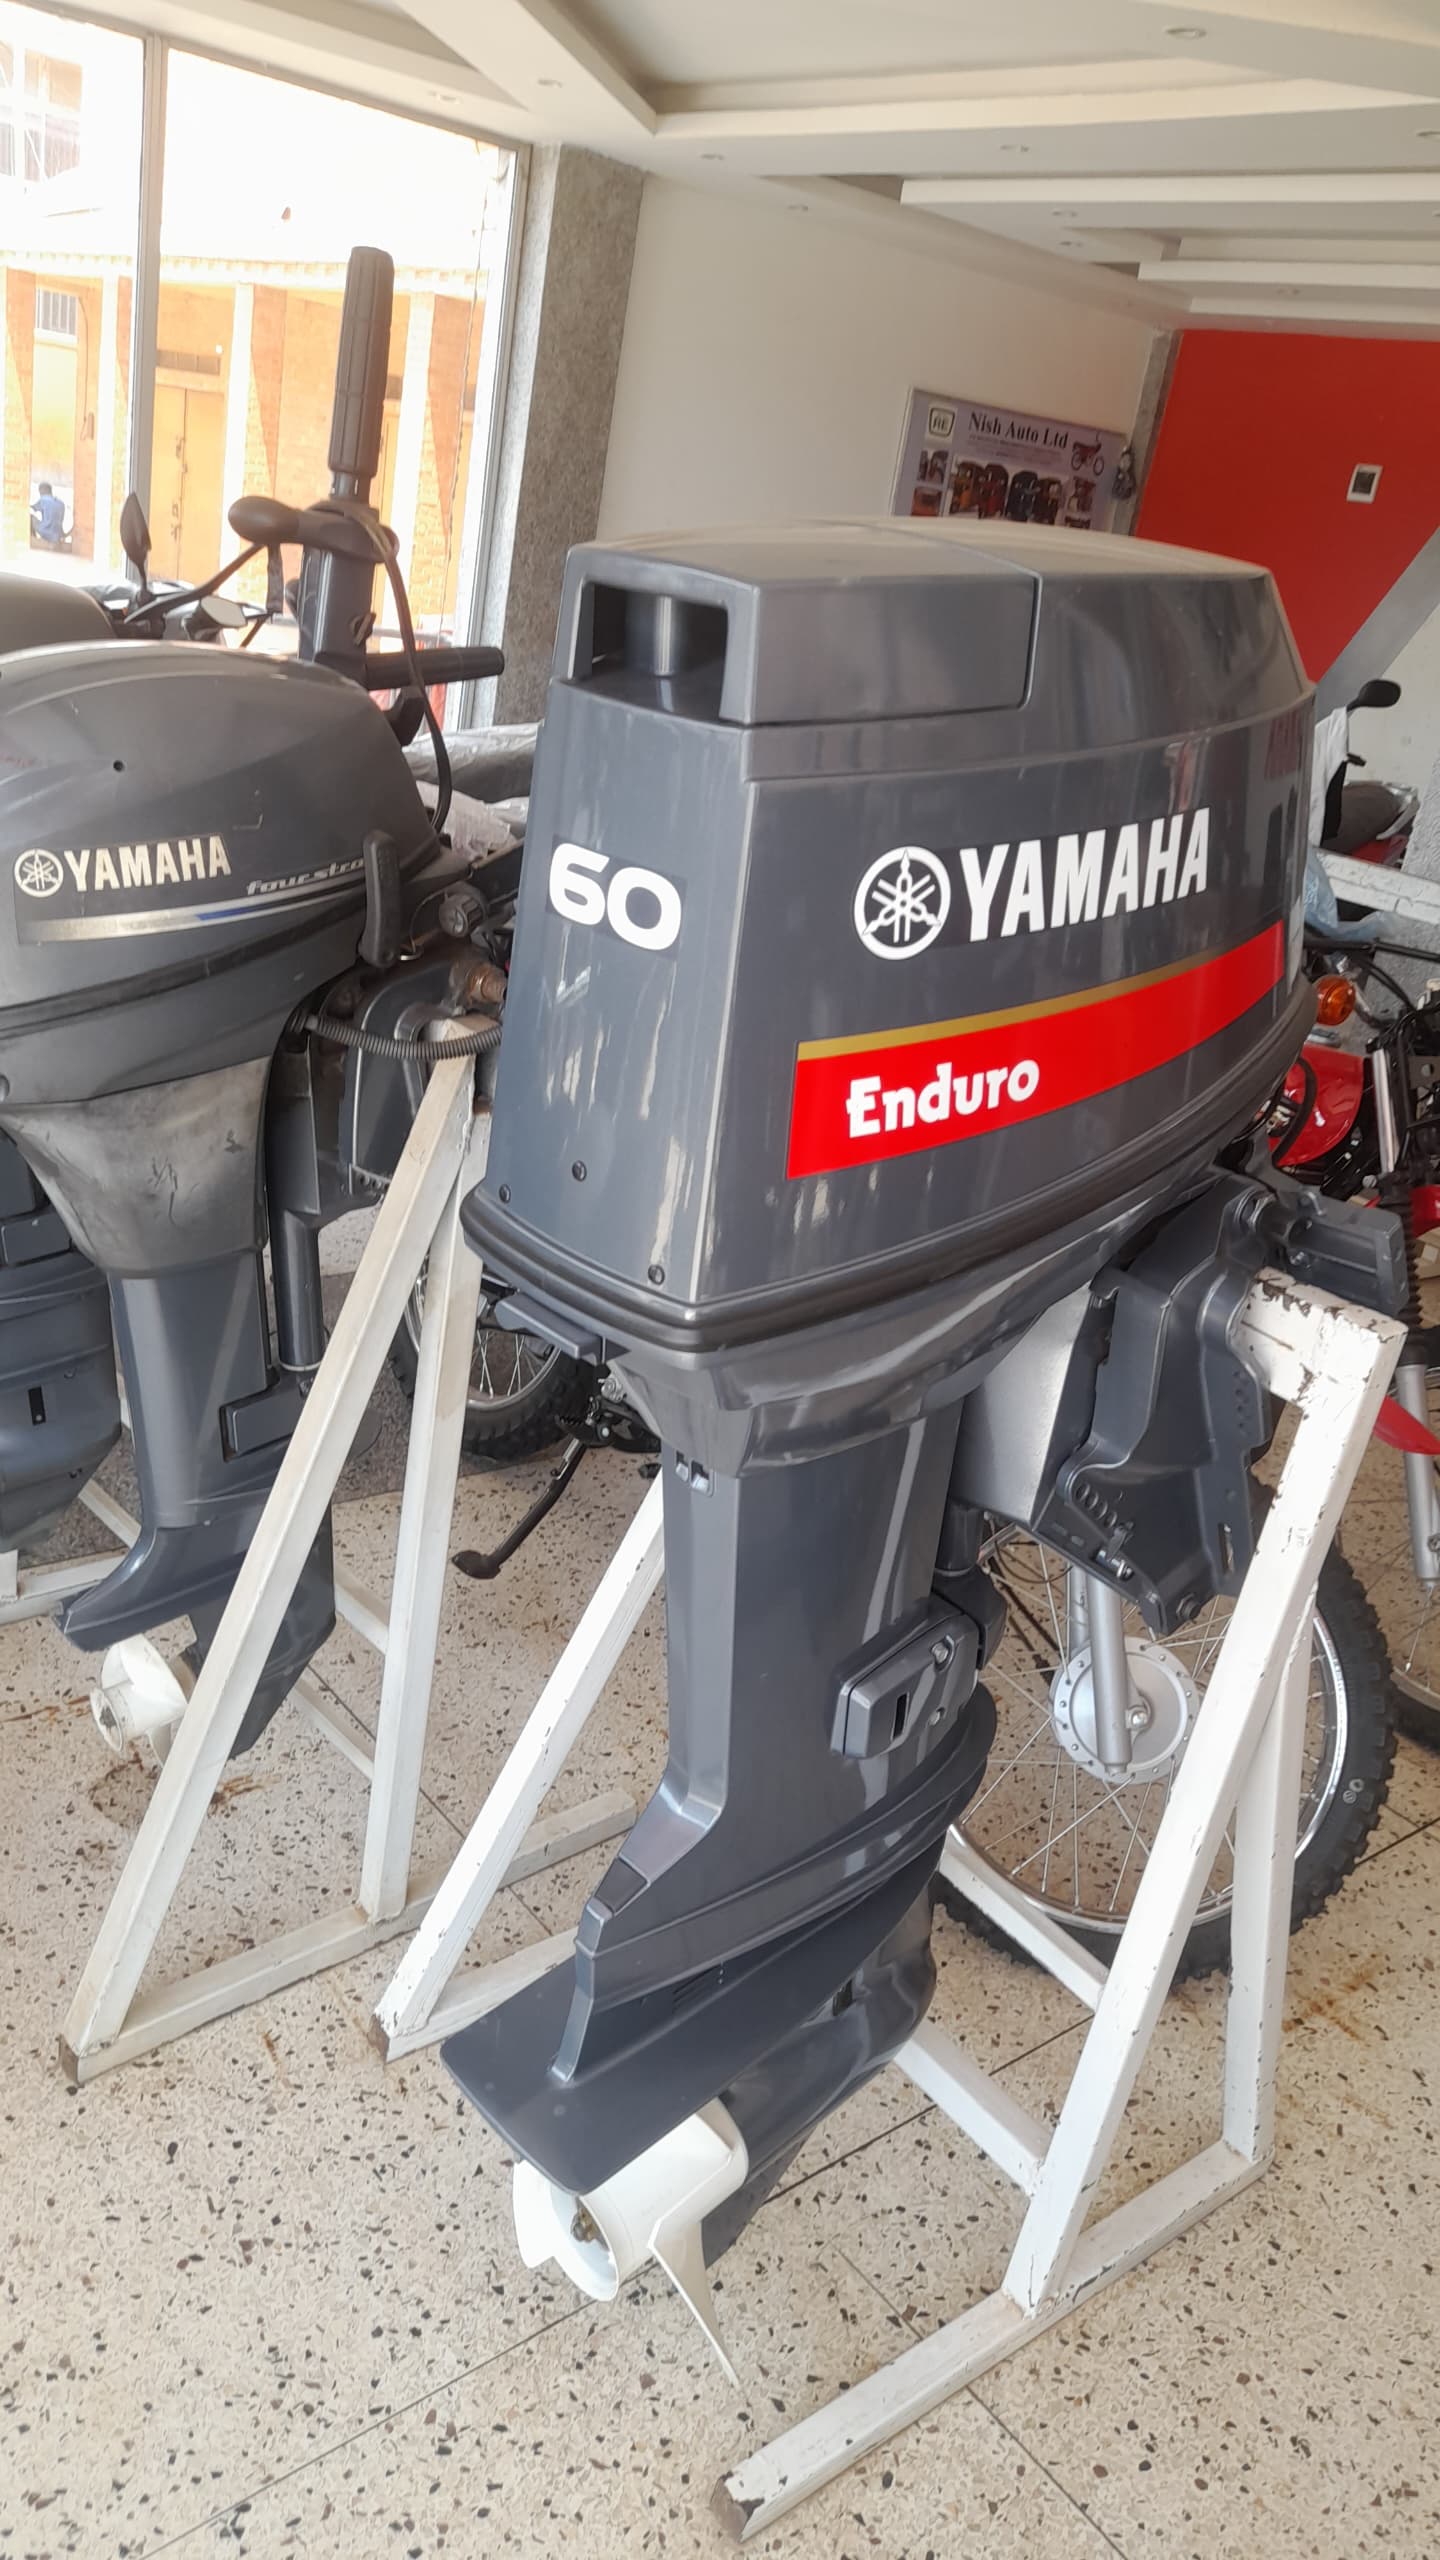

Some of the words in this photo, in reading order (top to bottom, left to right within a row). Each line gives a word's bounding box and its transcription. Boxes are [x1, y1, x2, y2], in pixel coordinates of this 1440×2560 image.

[968, 411, 1002, 435] Nish
[1005, 421, 1039, 443] Auto
[1043, 427, 1069, 449] Ltd
[64, 835, 232, 892] YAMAHA
[549, 842, 682, 951] 60
[960, 808, 1210, 942] YAMAHA
[846, 1059, 1041, 1138] Enduro
